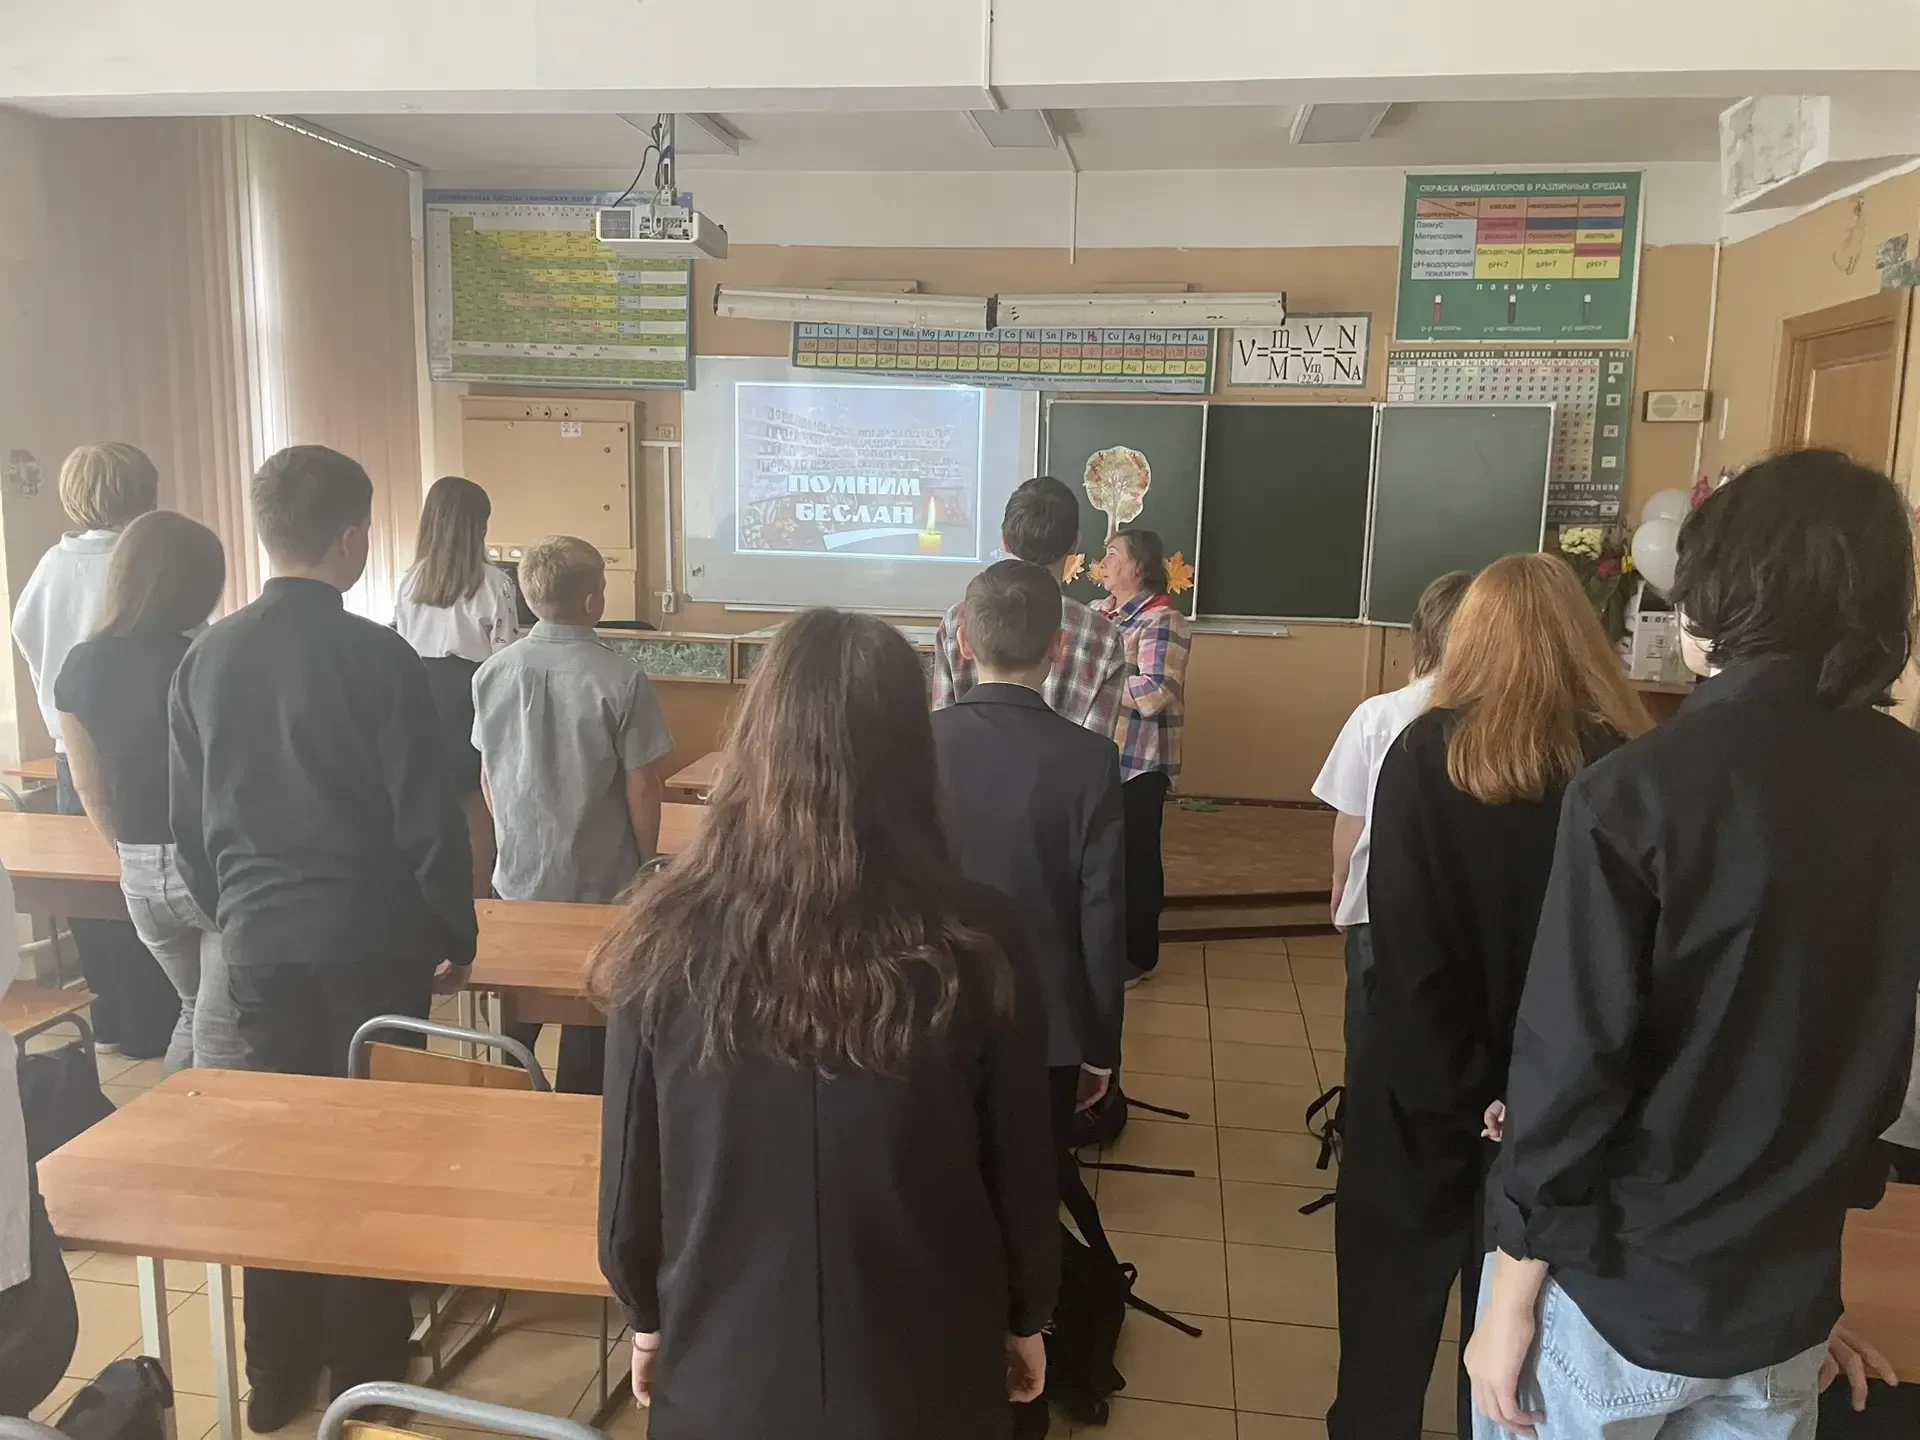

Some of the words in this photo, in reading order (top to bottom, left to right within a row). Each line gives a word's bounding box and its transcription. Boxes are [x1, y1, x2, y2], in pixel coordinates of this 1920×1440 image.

[1420, 184, 1459, 192] ОКРАСКА
[1461, 183, 1525, 192] ИНДИКАТОРОВ
[1527, 183, 1533, 191] В
[1535, 183, 1590, 191] РАЗЛИЧНЫХ
[1592, 182, 1627, 190] СРЕДАХ
[805, 327, 812, 335] Li
[823, 327, 833, 335] Cs
[883, 328, 893, 336] Ca
[902, 329, 914, 337] Na
[922, 330, 935, 338] Mg
[1026, 331, 1036, 339] Ni
[1046, 331, 1056, 339] Sn
[1108, 332, 1119, 340] Cu
[1128, 333, 1141, 342] Ag
[1149, 333, 1162, 342] Hg
[1191, 333, 1204, 341] Au
[1272, 329, 1290, 348] m
[1339, 324, 1357, 348] N
[1268, 356, 1288, 380] M
[787, 474, 920, 496] ПОМНИМ
[795, 503, 913, 524] БЕСЛАН
